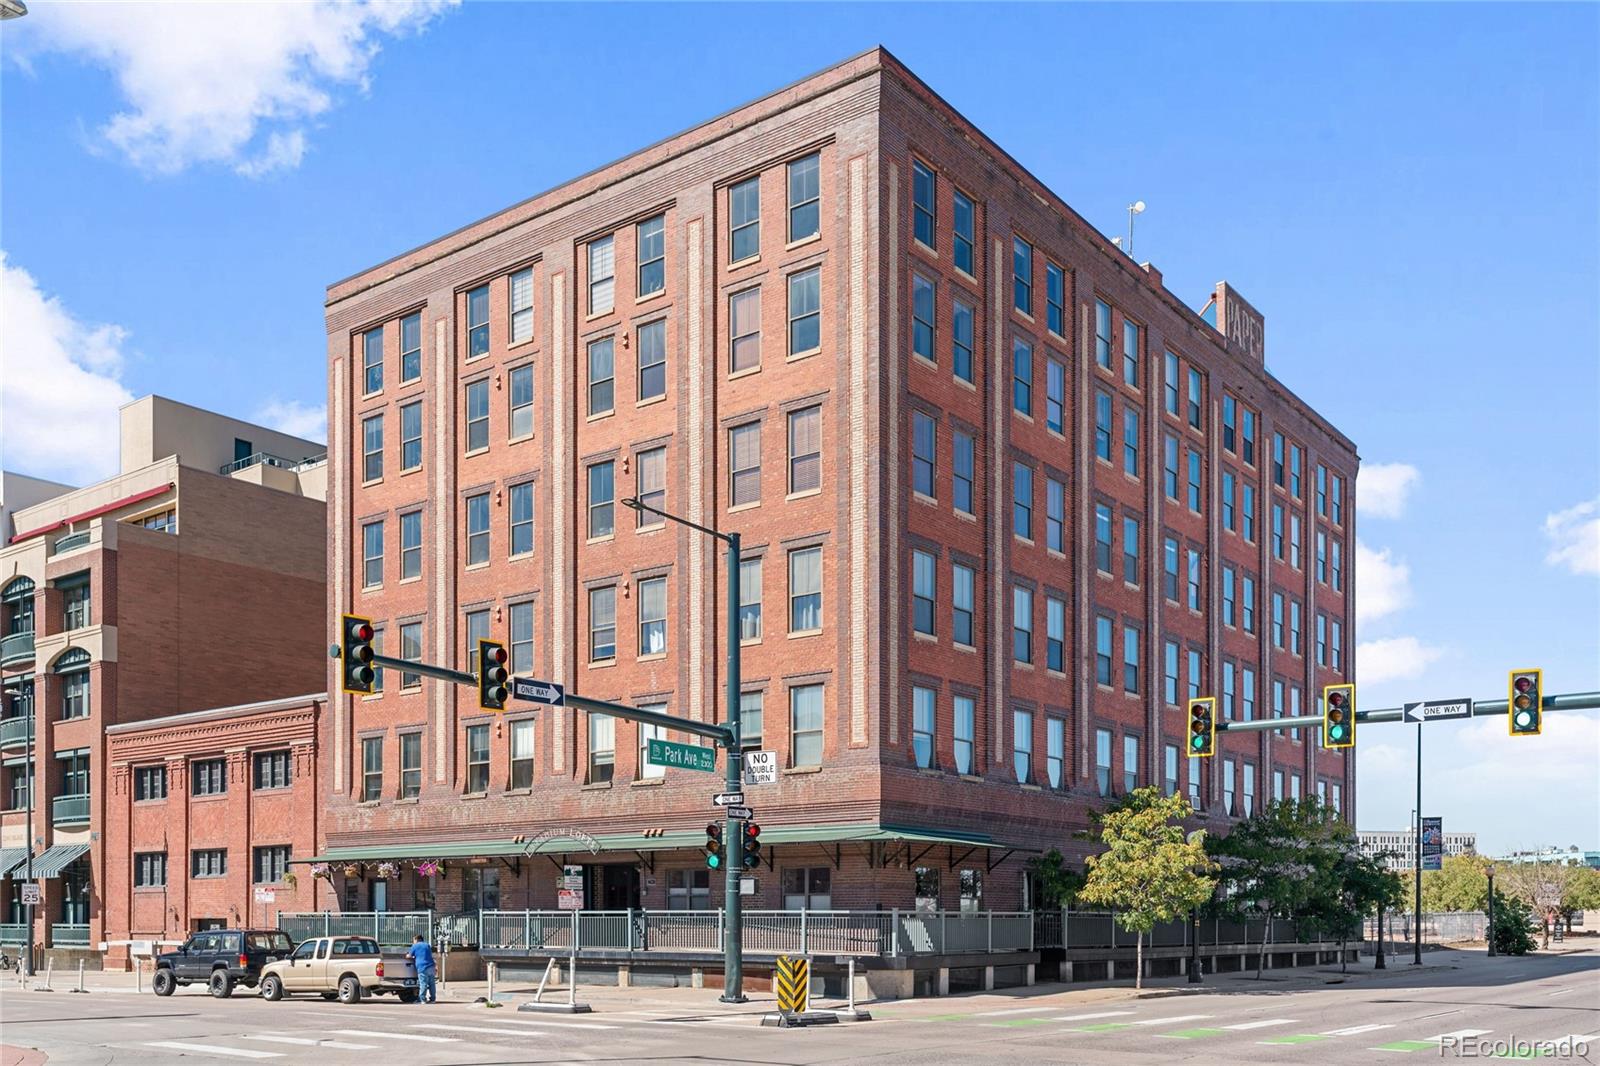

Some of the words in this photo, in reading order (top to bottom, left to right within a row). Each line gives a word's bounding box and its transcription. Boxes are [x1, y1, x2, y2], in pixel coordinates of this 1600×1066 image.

[520, 685, 534, 695] ONE
[536, 688, 549, 697] WAY
[1423, 707, 1440, 715] ONE
[1443, 705, 1461, 713] WAY
[664, 746, 682, 764] Park
[684, 749, 698, 766] Ave
[753, 753, 768, 764] NO
[747, 765, 774, 774] DOUBLE
[752, 774, 771, 783] TURN
[569, 828, 597, 848] LOFTS
[24, 894, 39, 902] 25
